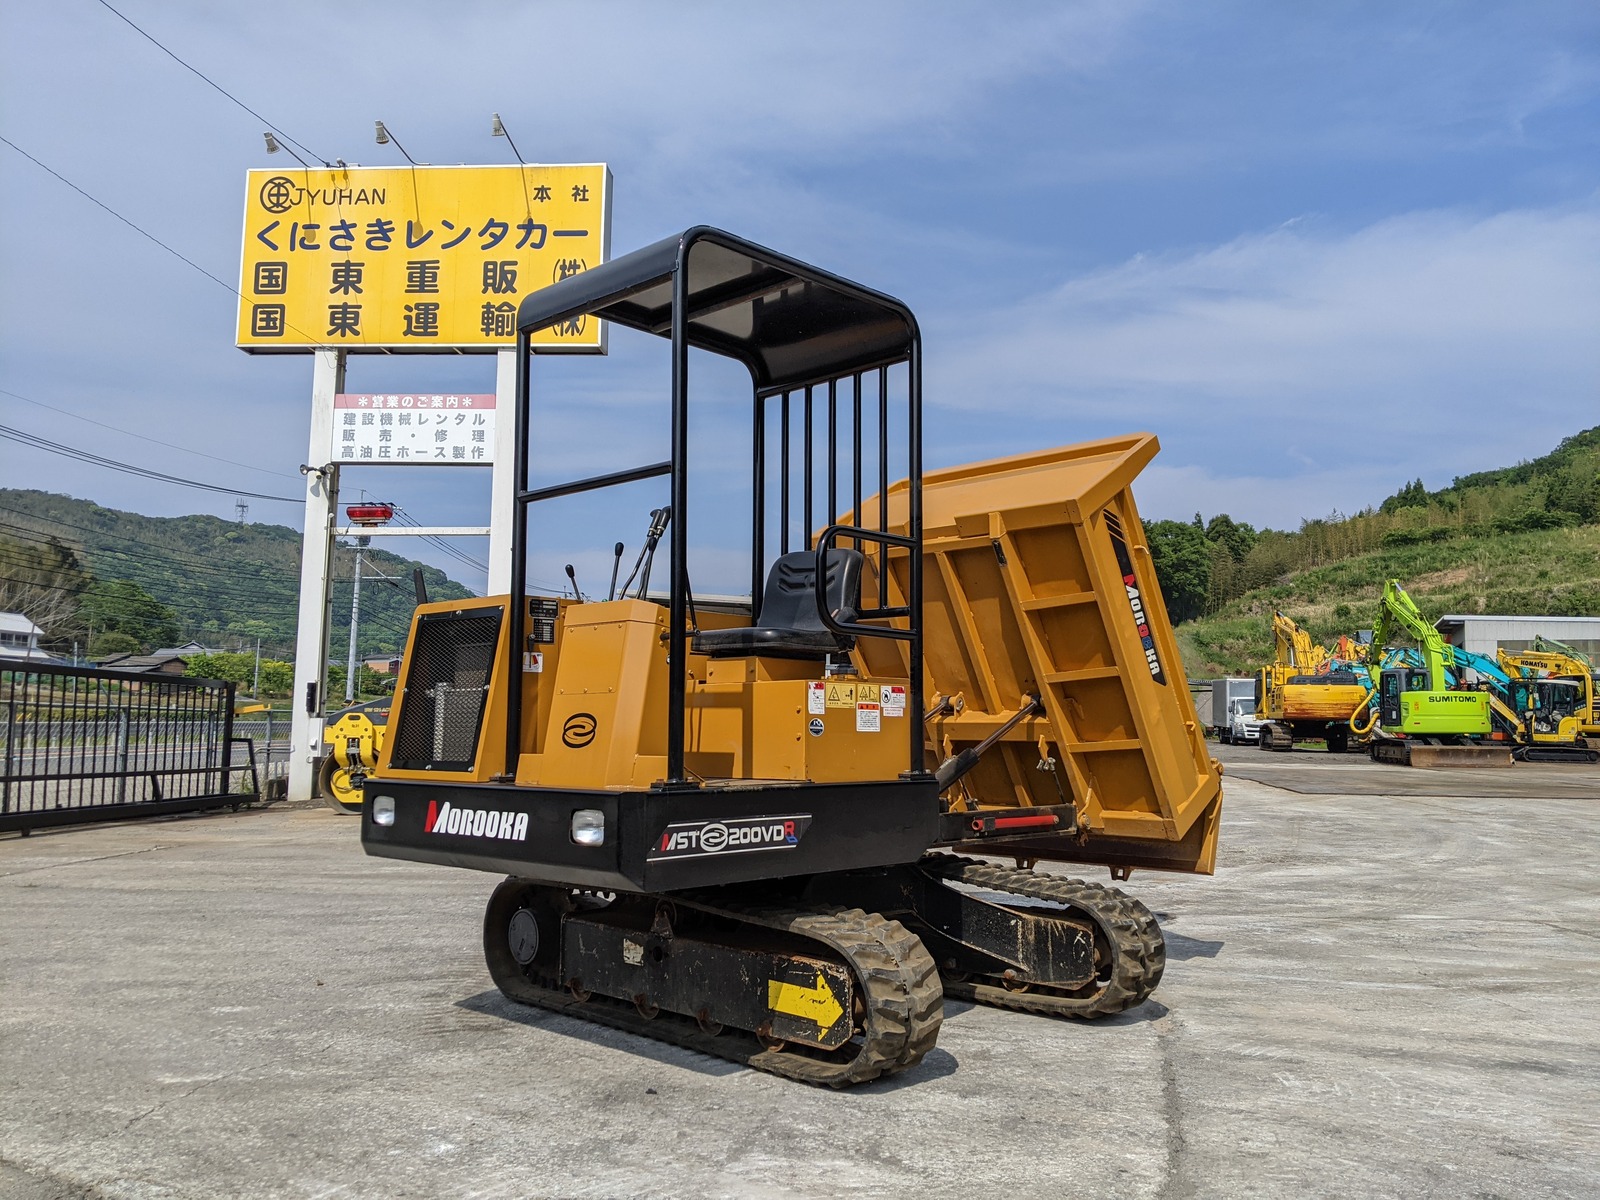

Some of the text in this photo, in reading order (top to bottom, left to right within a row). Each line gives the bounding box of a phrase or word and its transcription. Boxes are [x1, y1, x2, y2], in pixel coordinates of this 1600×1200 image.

[290, 188, 386, 206] JYUHAN
[256, 217, 589, 252] くにさきレンタカー
[343, 412, 486, 426] 建設機械レンタル
[341, 445, 485, 460] 高油圧ホース製作
[1520, 660, 1548, 669] KOMATSU
[1428, 695, 1477, 703] SUMITOMO
[424, 800, 529, 841] MOROOKA
[661, 831, 700, 851] MST
